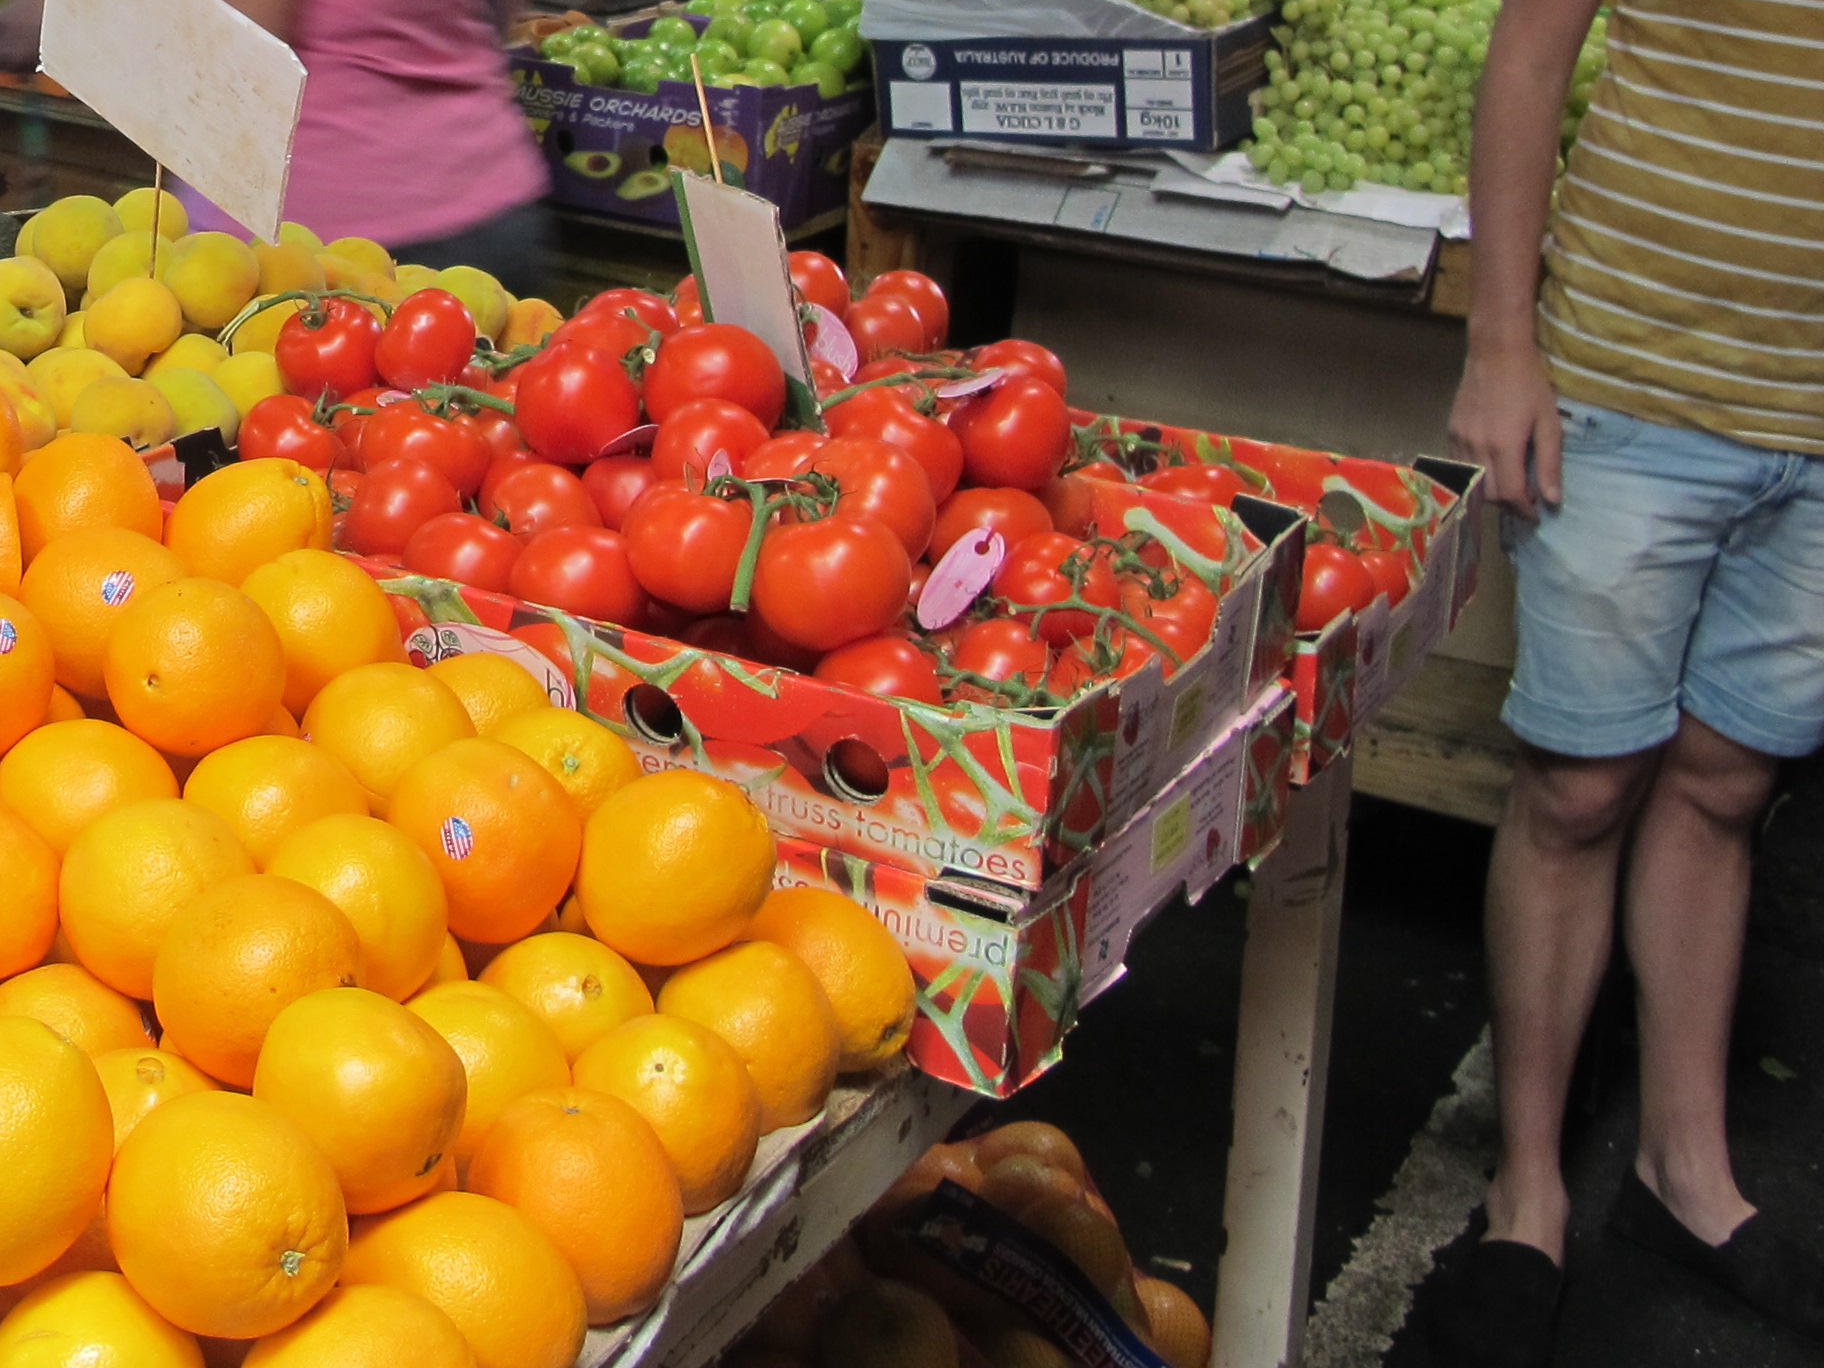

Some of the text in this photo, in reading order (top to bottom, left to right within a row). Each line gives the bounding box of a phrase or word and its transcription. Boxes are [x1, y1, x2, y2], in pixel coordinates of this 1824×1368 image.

[952, 49, 1027, 66] AUSTRALIA
[1028, 50, 1047, 65] OF
[1050, 50, 1120, 66] PRODUCE
[588, 95, 703, 128] ORCHARDS
[1139, 110, 1182, 129] 10kg
[764, 788, 843, 832] truss
[853, 810, 1028, 882] tomatoes
